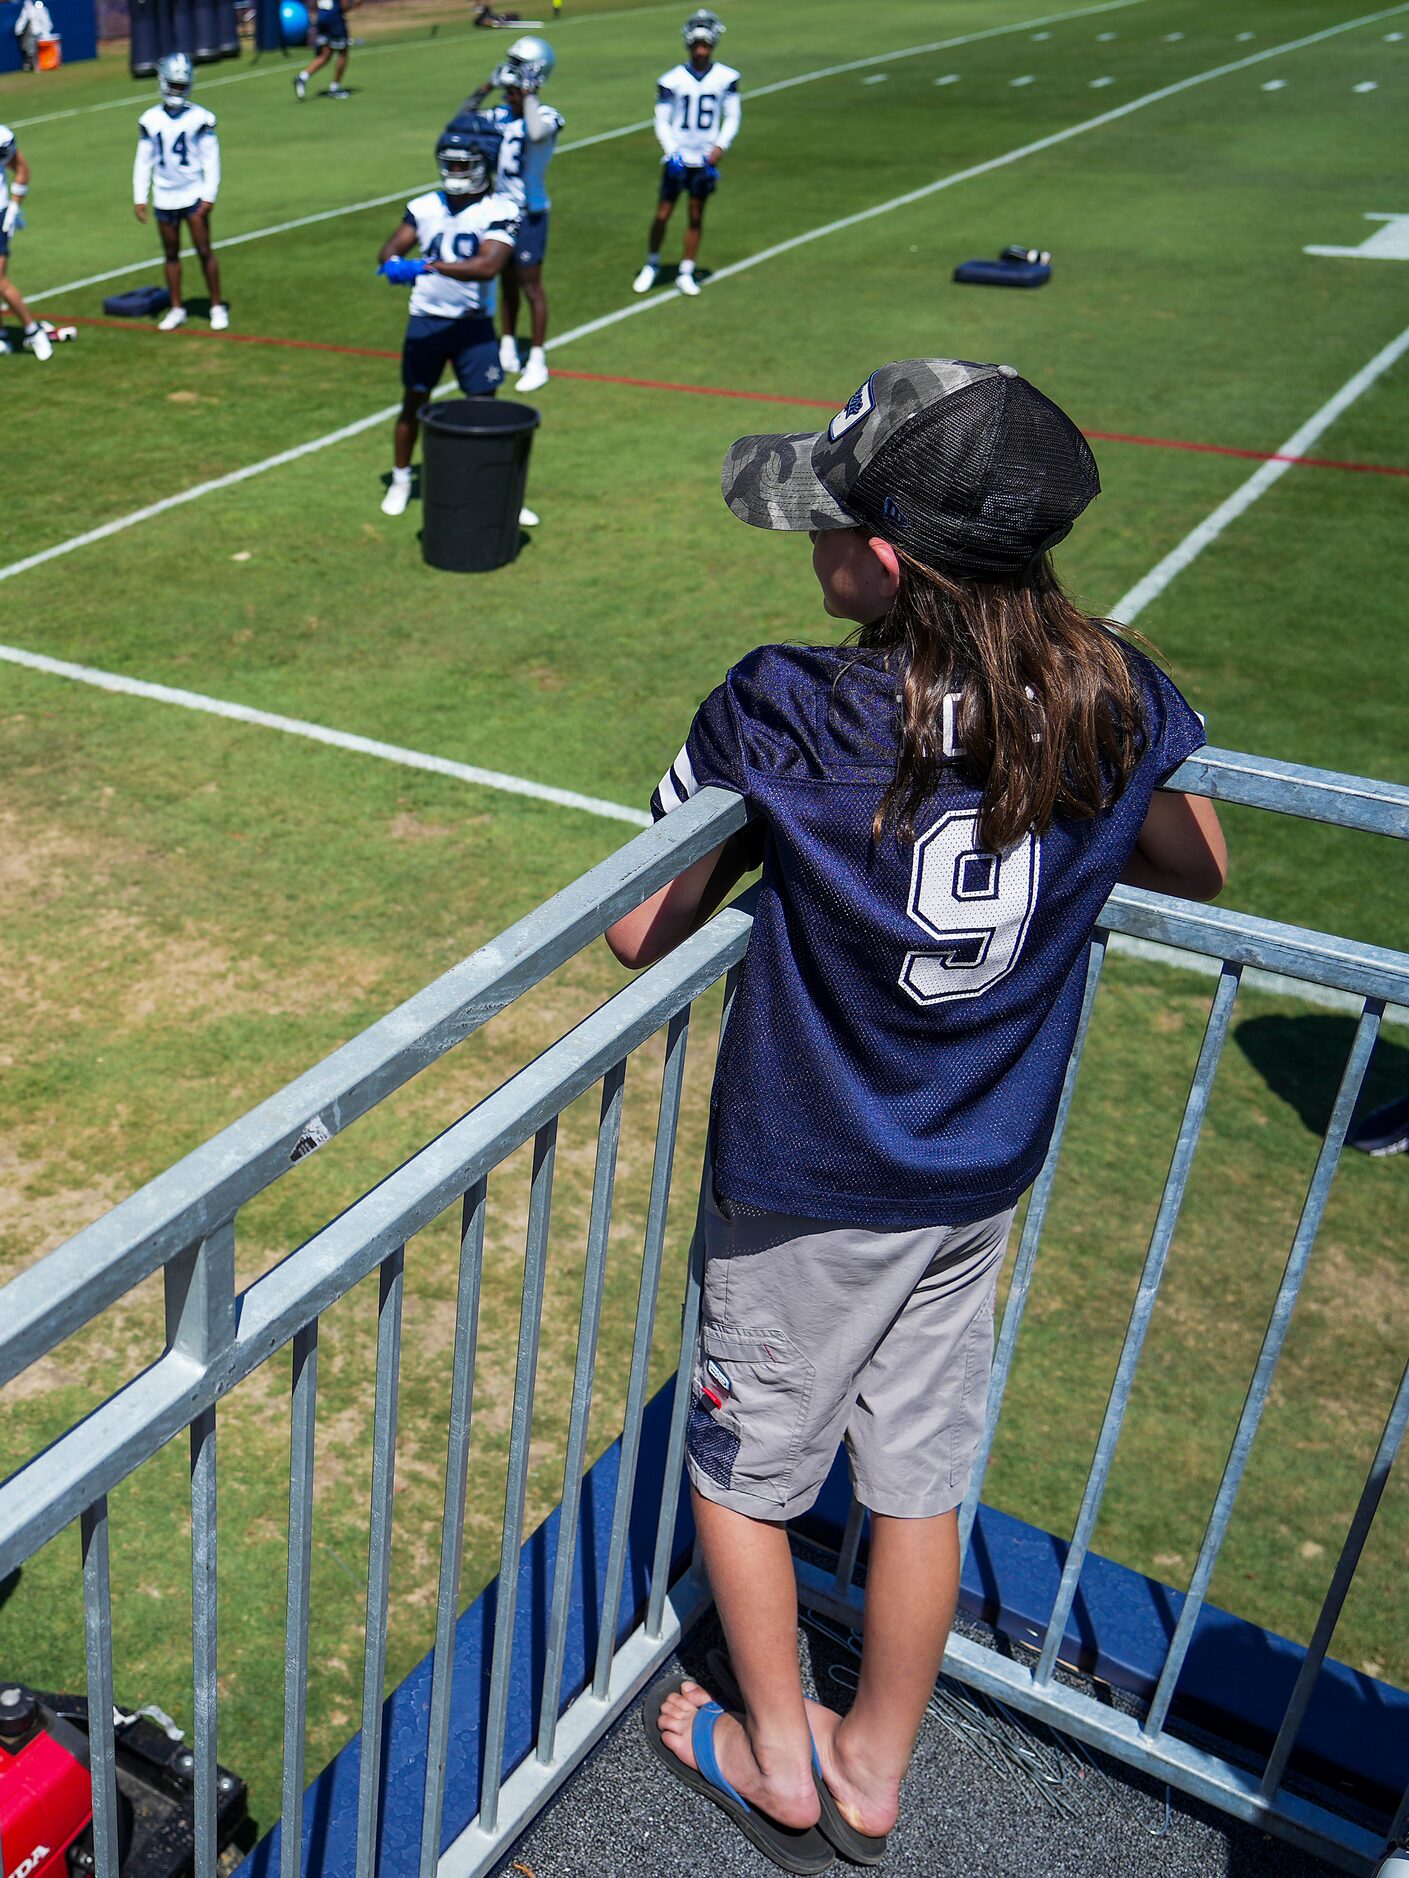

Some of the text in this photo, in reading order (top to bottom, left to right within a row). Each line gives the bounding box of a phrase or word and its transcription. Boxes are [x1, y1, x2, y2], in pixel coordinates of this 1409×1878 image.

[680, 94, 716, 130] 16
[156, 131, 191, 167] 14
[898, 808, 1040, 1006] 9
